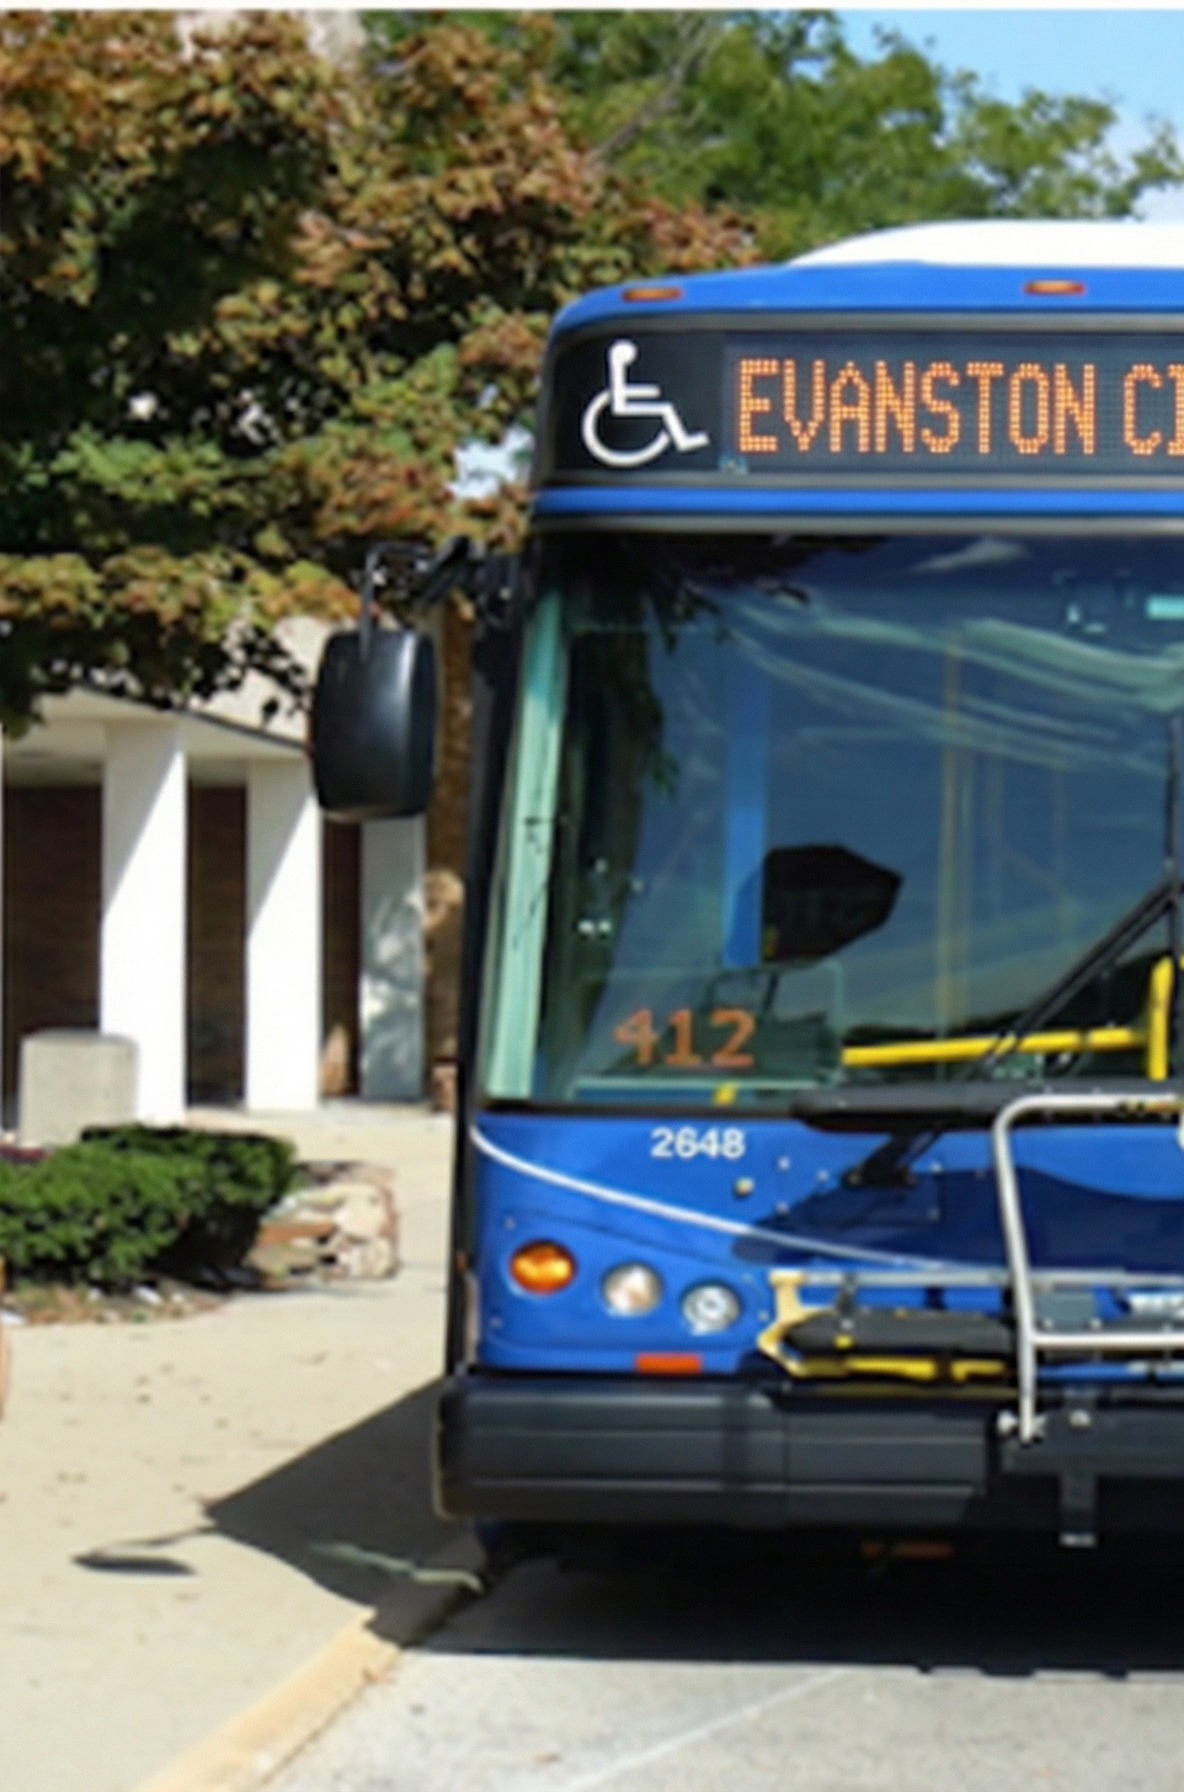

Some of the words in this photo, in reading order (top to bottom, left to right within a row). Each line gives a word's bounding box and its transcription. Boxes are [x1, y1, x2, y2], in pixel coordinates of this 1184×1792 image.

[737, 358, 1096, 454] EVANSTON
[612, 1007, 757, 1069] 412
[650, 1126, 746, 1159] 2648
